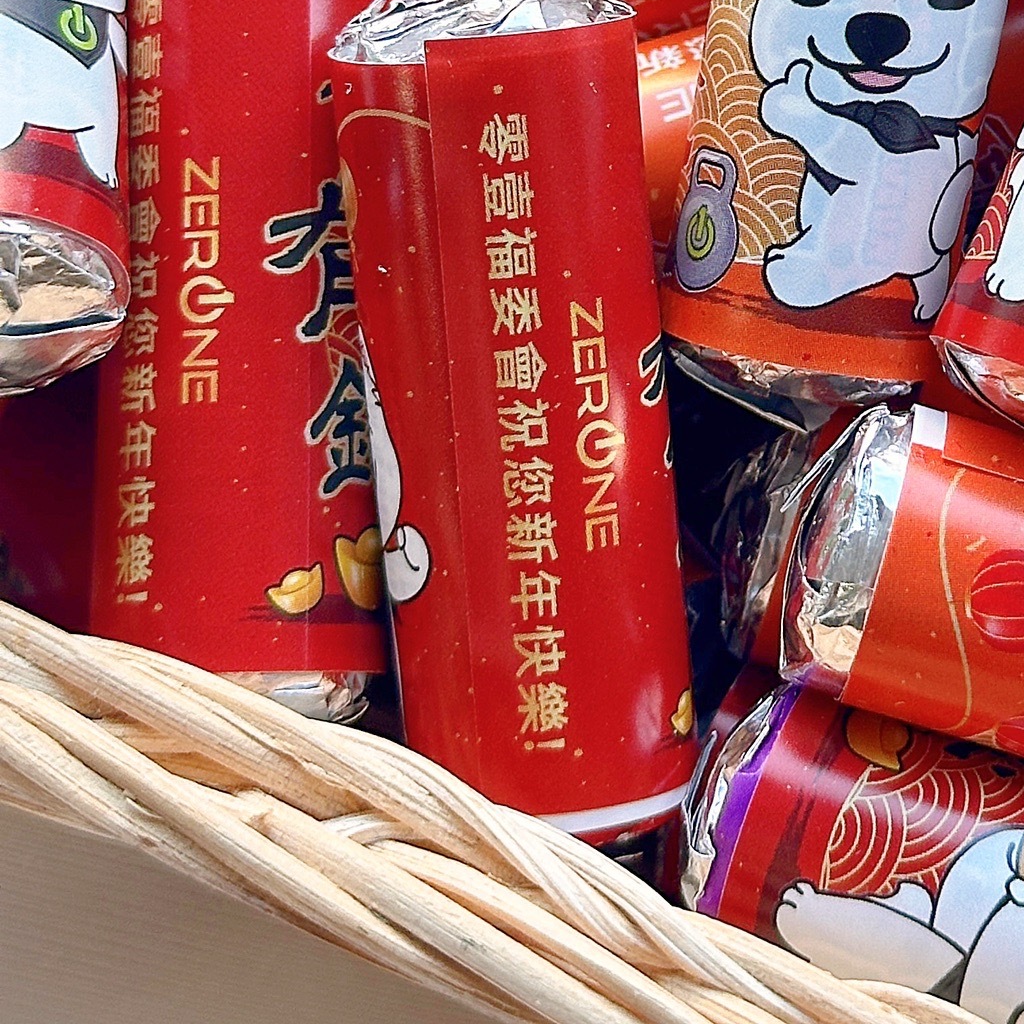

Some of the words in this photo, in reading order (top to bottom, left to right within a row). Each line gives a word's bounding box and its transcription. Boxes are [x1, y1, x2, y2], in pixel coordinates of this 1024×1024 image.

[180, 156, 236, 405] ZERONE
[479, 112, 569, 754] 零壹福委會祝您新年快樂!
[567, 295, 628, 550] ZERONE
